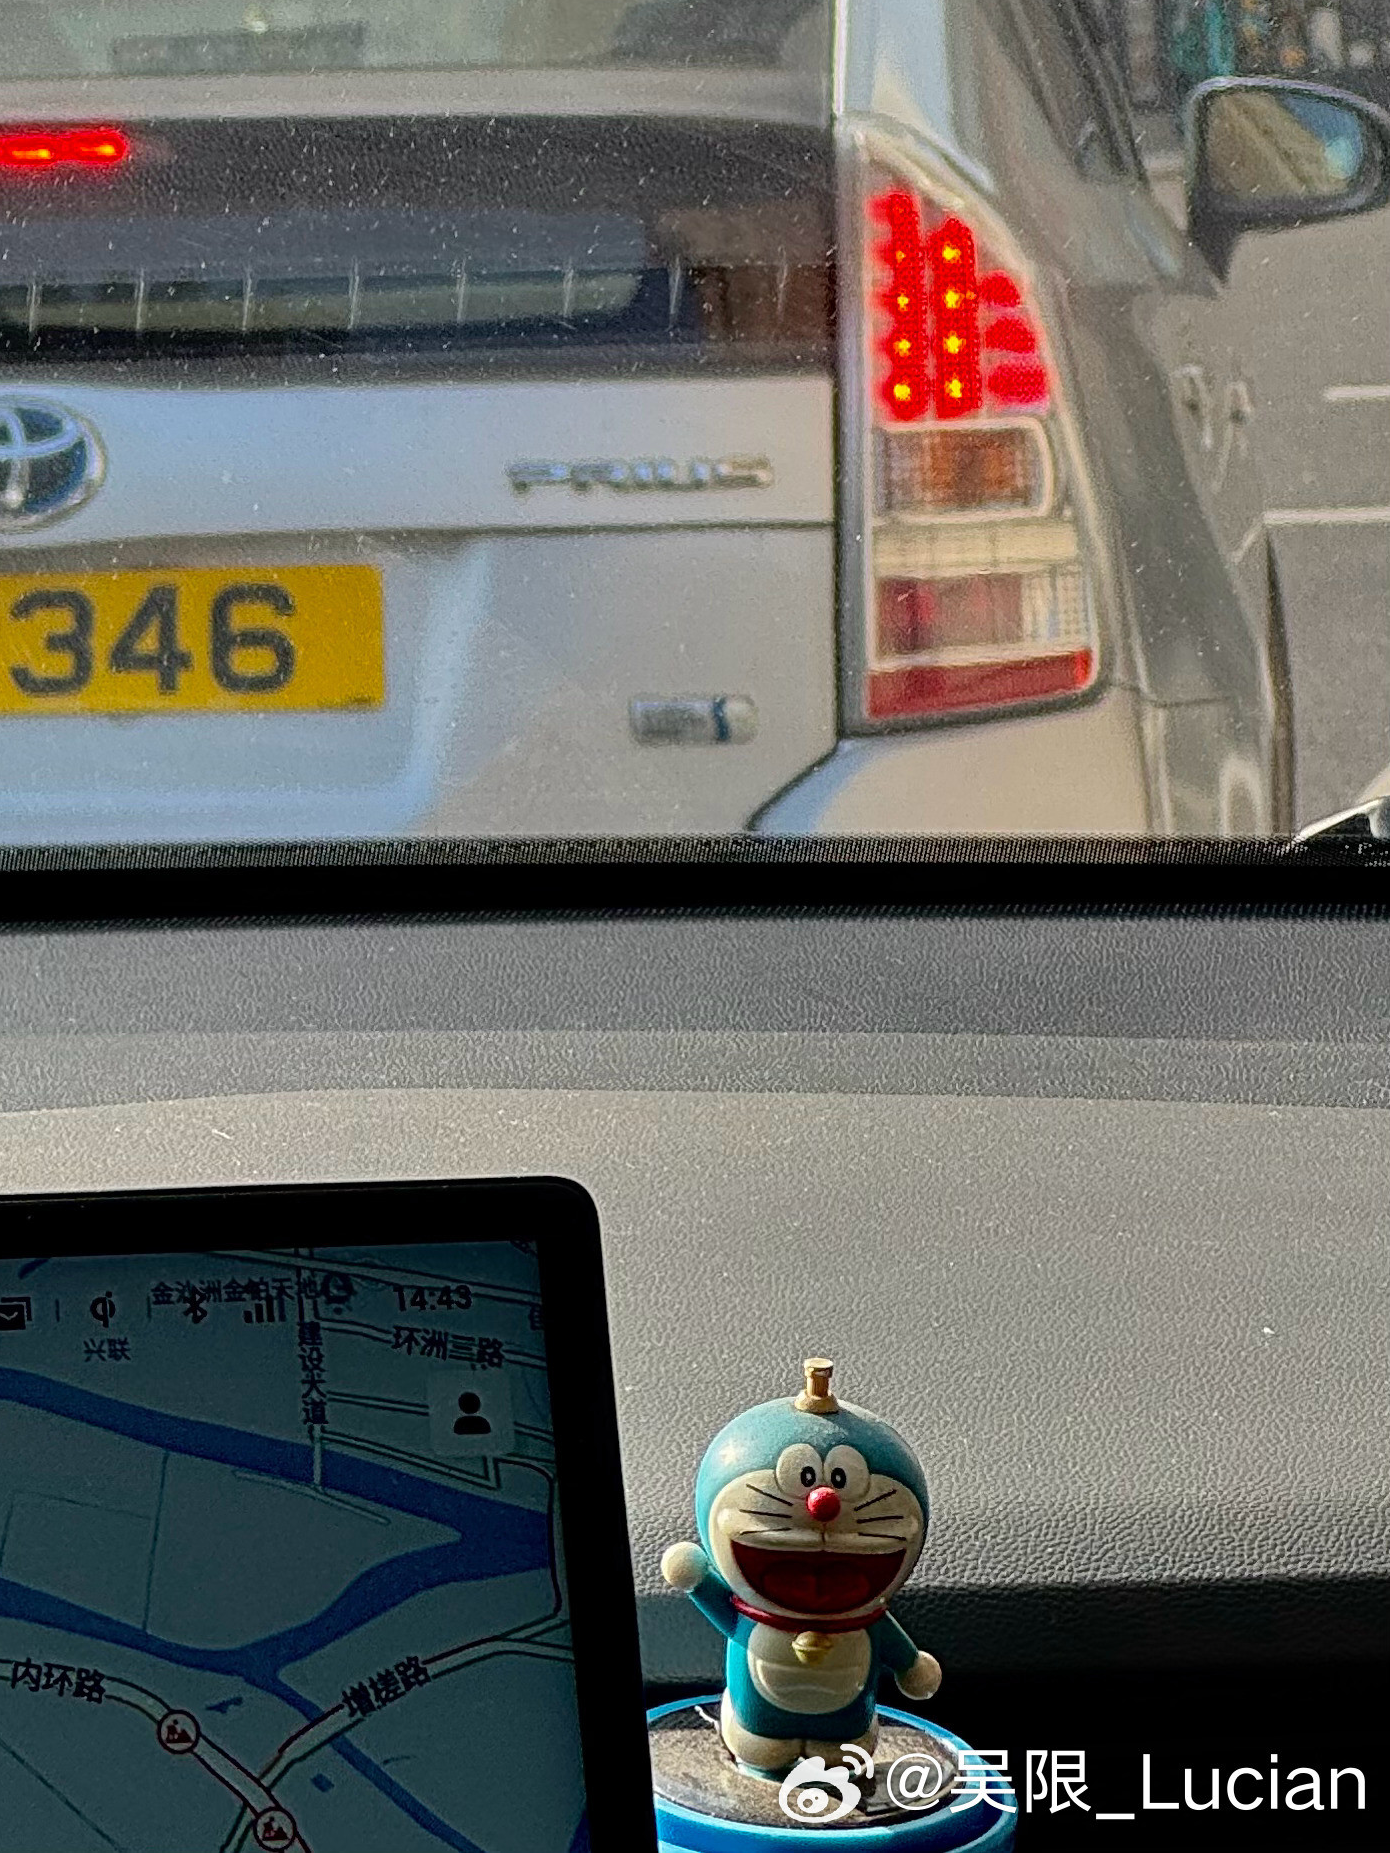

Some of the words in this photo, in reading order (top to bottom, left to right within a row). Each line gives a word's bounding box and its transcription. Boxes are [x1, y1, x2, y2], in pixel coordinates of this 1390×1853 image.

[9, 583, 296, 696] 346
[393, 1285, 473, 1311] 14:43
[298, 1321, 328, 1426] 建设大道
[392, 1324, 505, 1368] 环洲三路
[11, 1658, 107, 1704] 内环路
[341, 1655, 433, 1719] 增槎路
